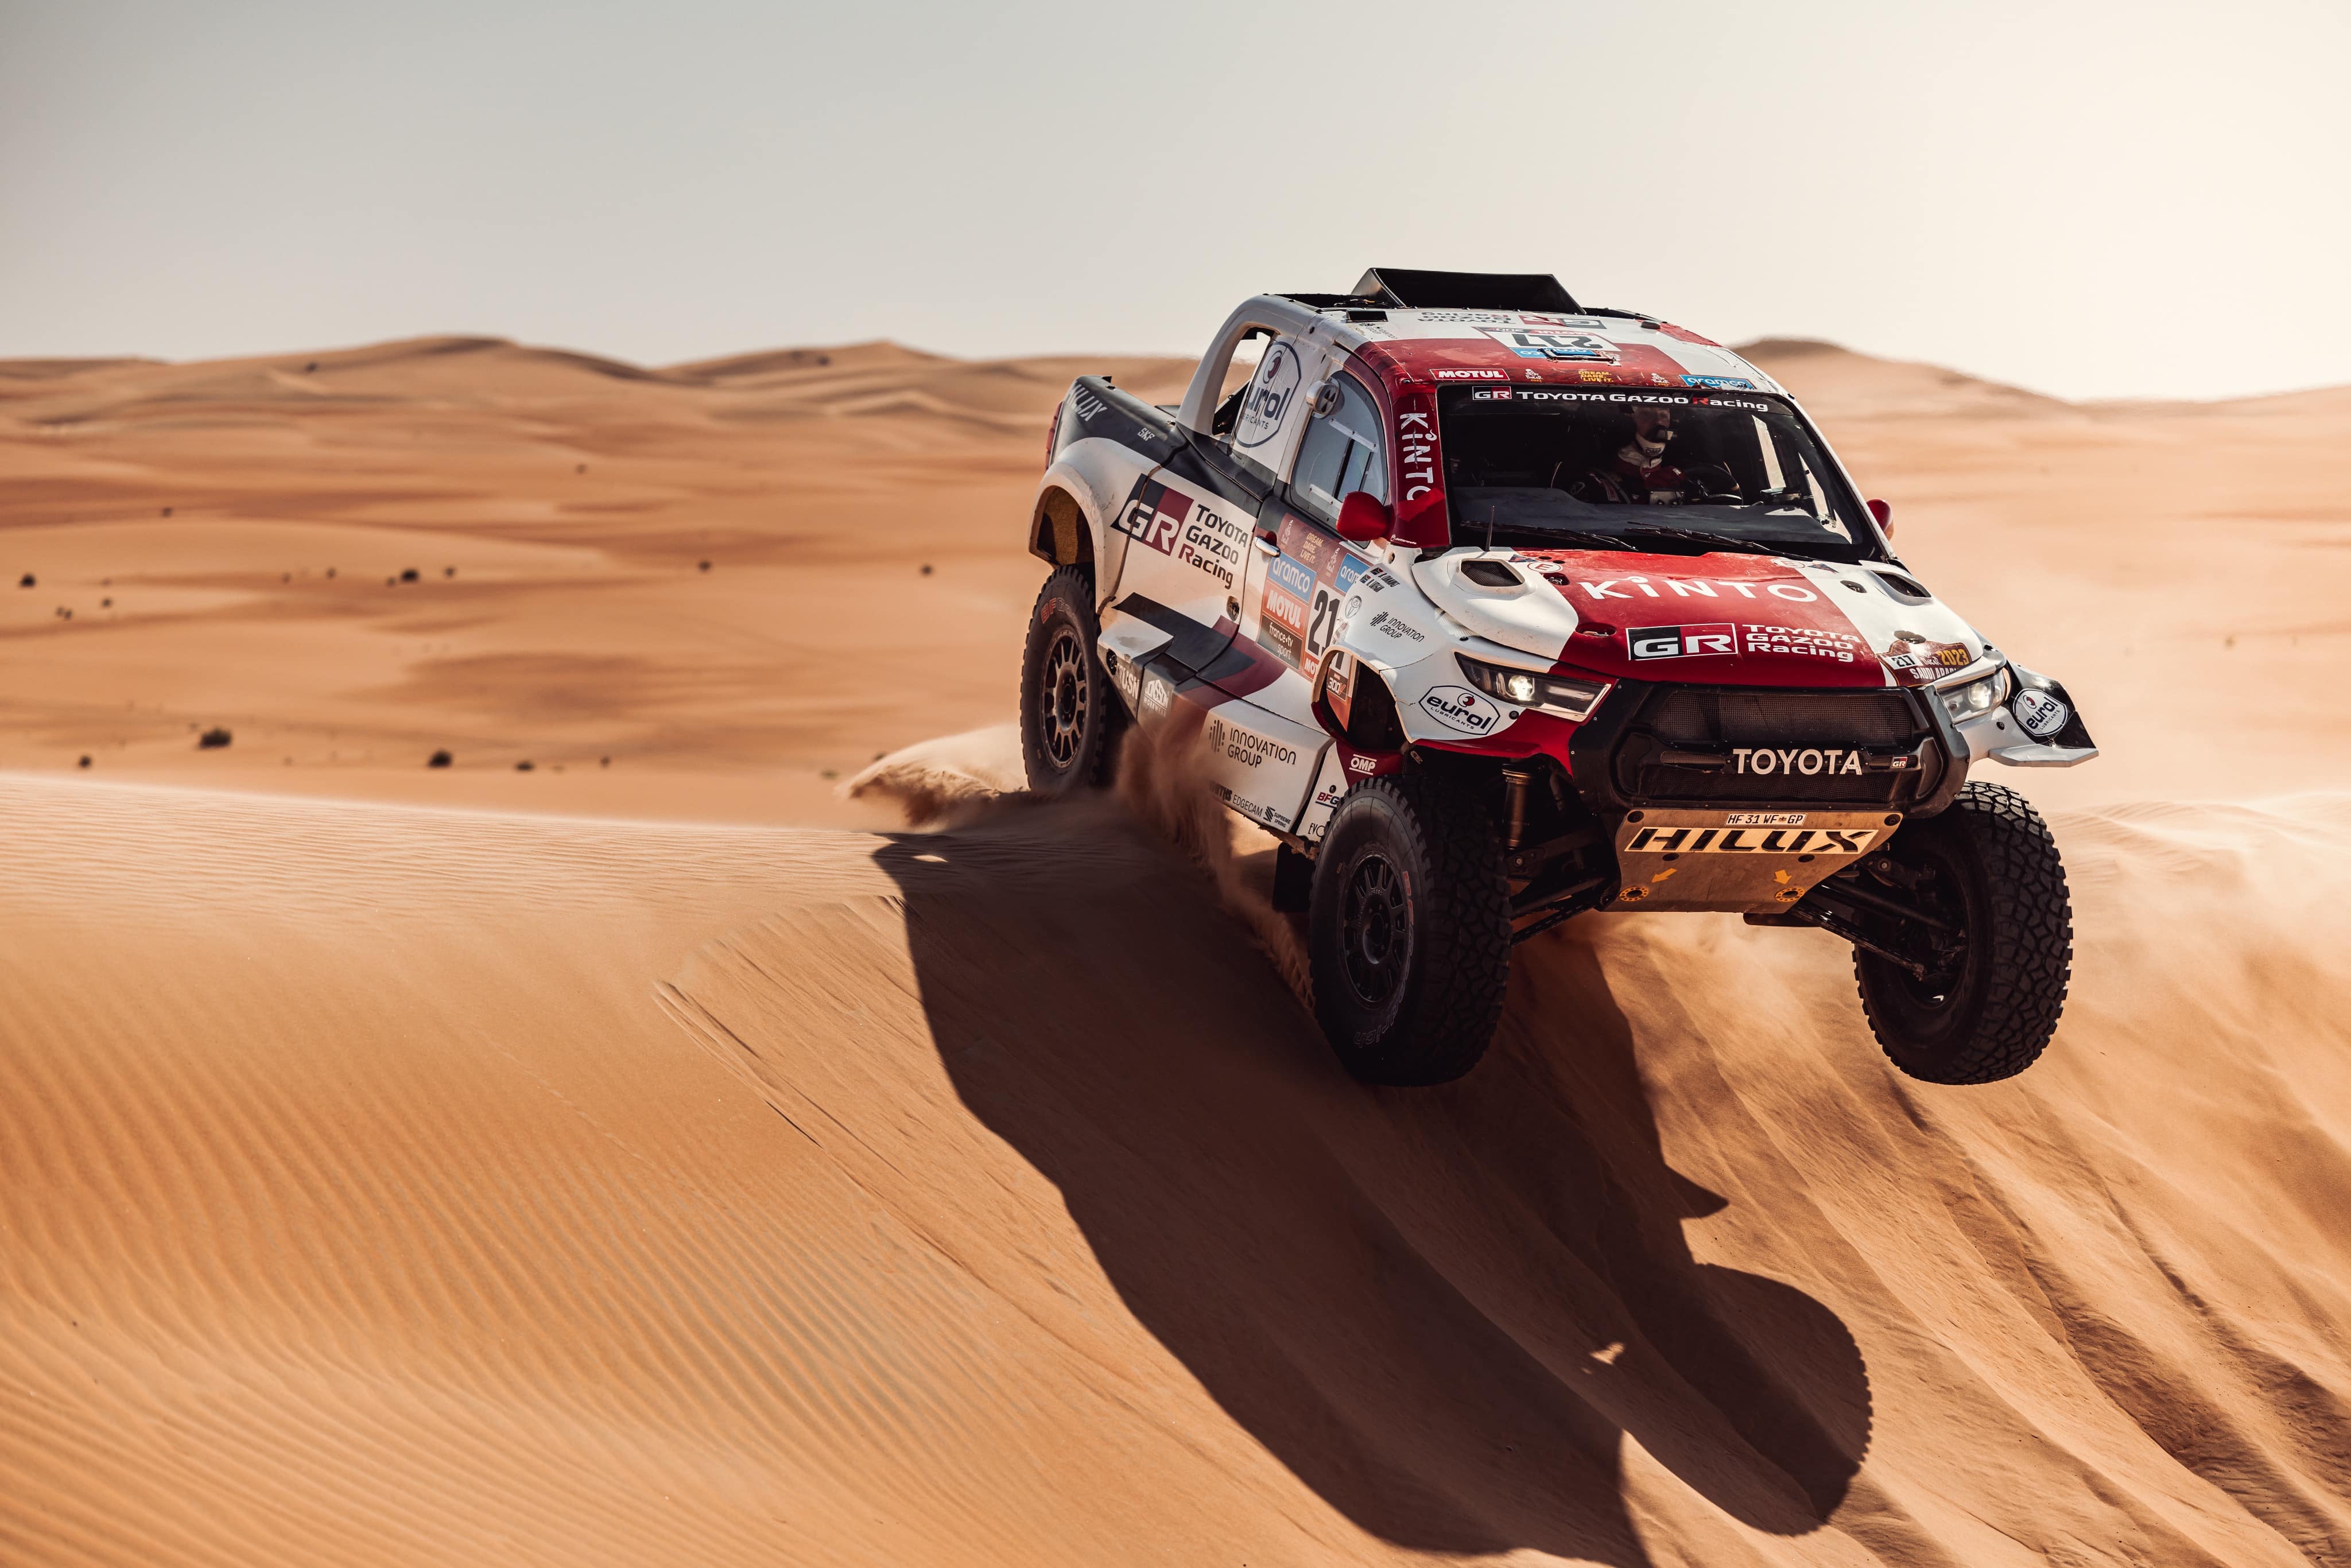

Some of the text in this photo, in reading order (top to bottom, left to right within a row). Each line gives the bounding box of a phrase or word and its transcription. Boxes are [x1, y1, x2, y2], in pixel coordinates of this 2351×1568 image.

[1512, 333, 1603, 349] 217
[1438, 370, 1504, 378] MOTUL
[1474, 391, 1768, 412] GR TOYOTA GAZOO Racing
[1137, 428, 1155, 441] SKF
[1118, 499, 1180, 552] GR
[1196, 503, 1249, 548] TOYOTA
[1185, 525, 1239, 565] GAZOO
[1178, 543, 1233, 590] Racing
[1273, 557, 1310, 593] aramco
[1266, 589, 1302, 629] MOTUL
[1380, 624, 1402, 639] GROUP
[1741, 624, 1861, 643] TOYOTA
[1745, 633, 1854, 650] GAZOO
[1277, 643, 1292, 661] sport
[1633, 635, 1734, 657] GR
[1748, 642, 1854, 662] Racing
[1891, 655, 1917, 667] 217
[1935, 649, 1969, 666] 2023
[1909, 667, 1935, 680] SAUDI
[1426, 696, 1492, 729] eurol
[1430, 707, 1475, 729] LUBRICANTS
[2026, 696, 2058, 729] eurol
[2040, 709, 2060, 730] LUBRICANTS
[1227, 744, 1262, 768] GROUP
[1350, 757, 1376, 772] OMP
[1733, 748, 1862, 775] TOYOTA
[1232, 794, 1263, 817] EDGECAM
[1274, 812, 1291, 824] SUPREME
[1274, 818, 1287, 828] SPRING
[1727, 814, 1803, 824] HF 31 WF GP
[1628, 828, 1874, 853] HILUX
